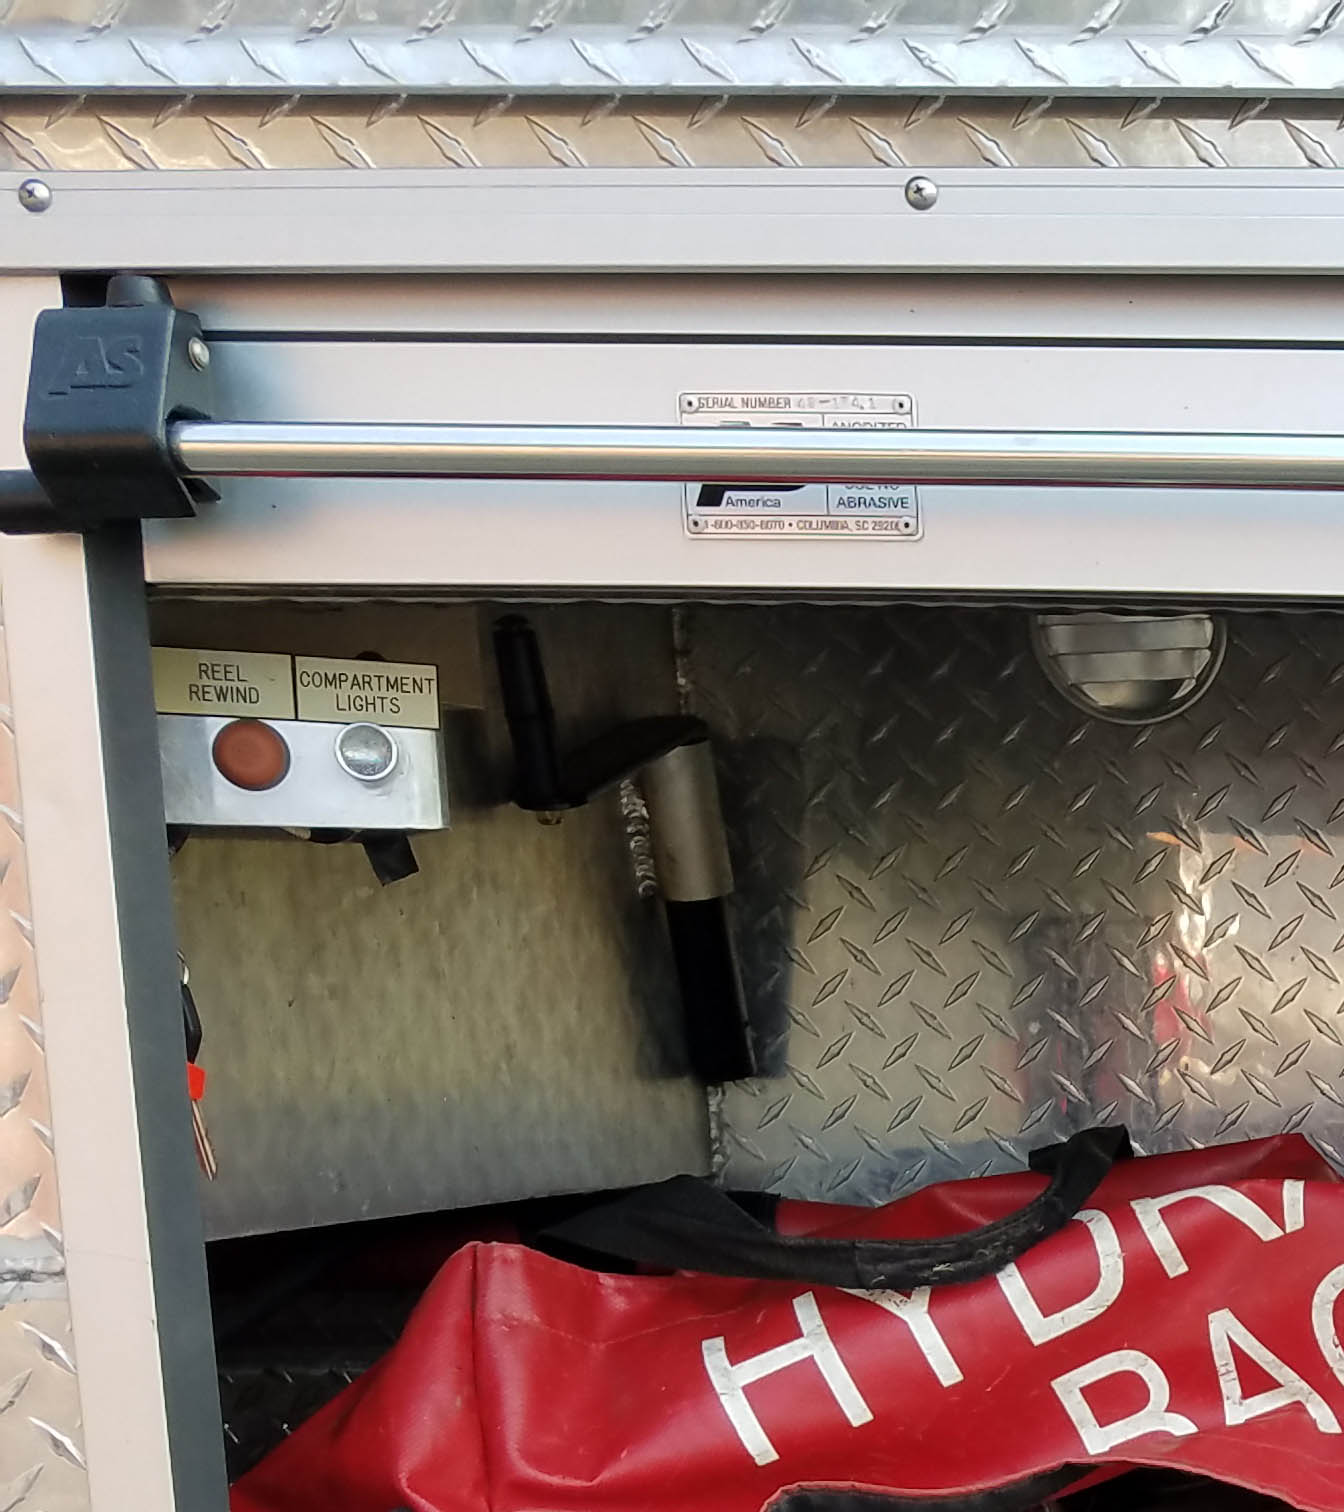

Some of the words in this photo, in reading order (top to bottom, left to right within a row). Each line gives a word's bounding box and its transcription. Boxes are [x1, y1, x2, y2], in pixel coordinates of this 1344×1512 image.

[698, 396, 737, 410] SERIAL
[741, 397, 791, 409] NUMBER
[725, 496, 781, 509] America
[836, 496, 909, 509] ABRASIVE
[855, 520, 869, 531] SC
[198, 662, 248, 683] REEL
[299, 670, 436, 696] COMPARTMENT
[188, 683, 260, 704] REWIND
[335, 693, 401, 714] LIGHTS
